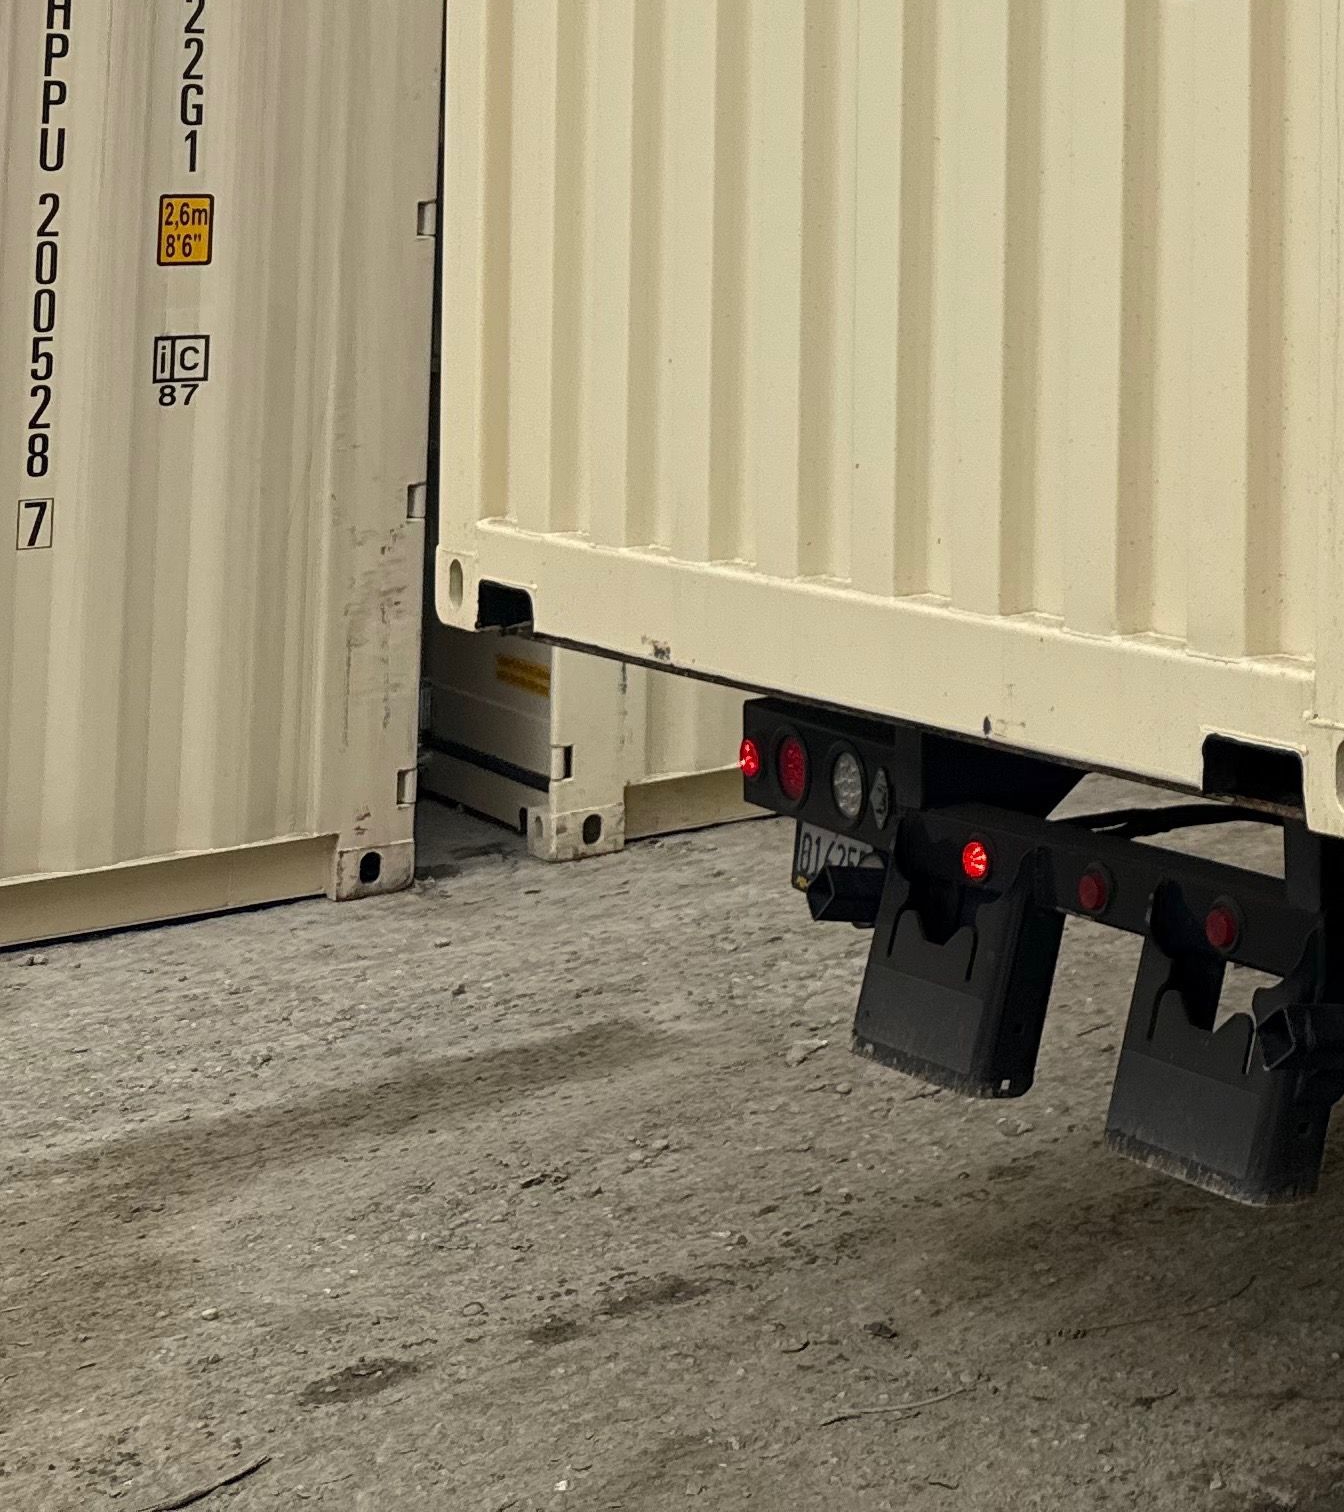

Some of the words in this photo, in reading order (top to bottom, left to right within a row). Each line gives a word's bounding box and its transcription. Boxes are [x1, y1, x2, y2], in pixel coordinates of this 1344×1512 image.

[163, 200, 209, 231] 2,6m
[27, 193, 59, 477] 200528
[156, 382, 198, 407] 87
[22, 502, 47, 550] 7
